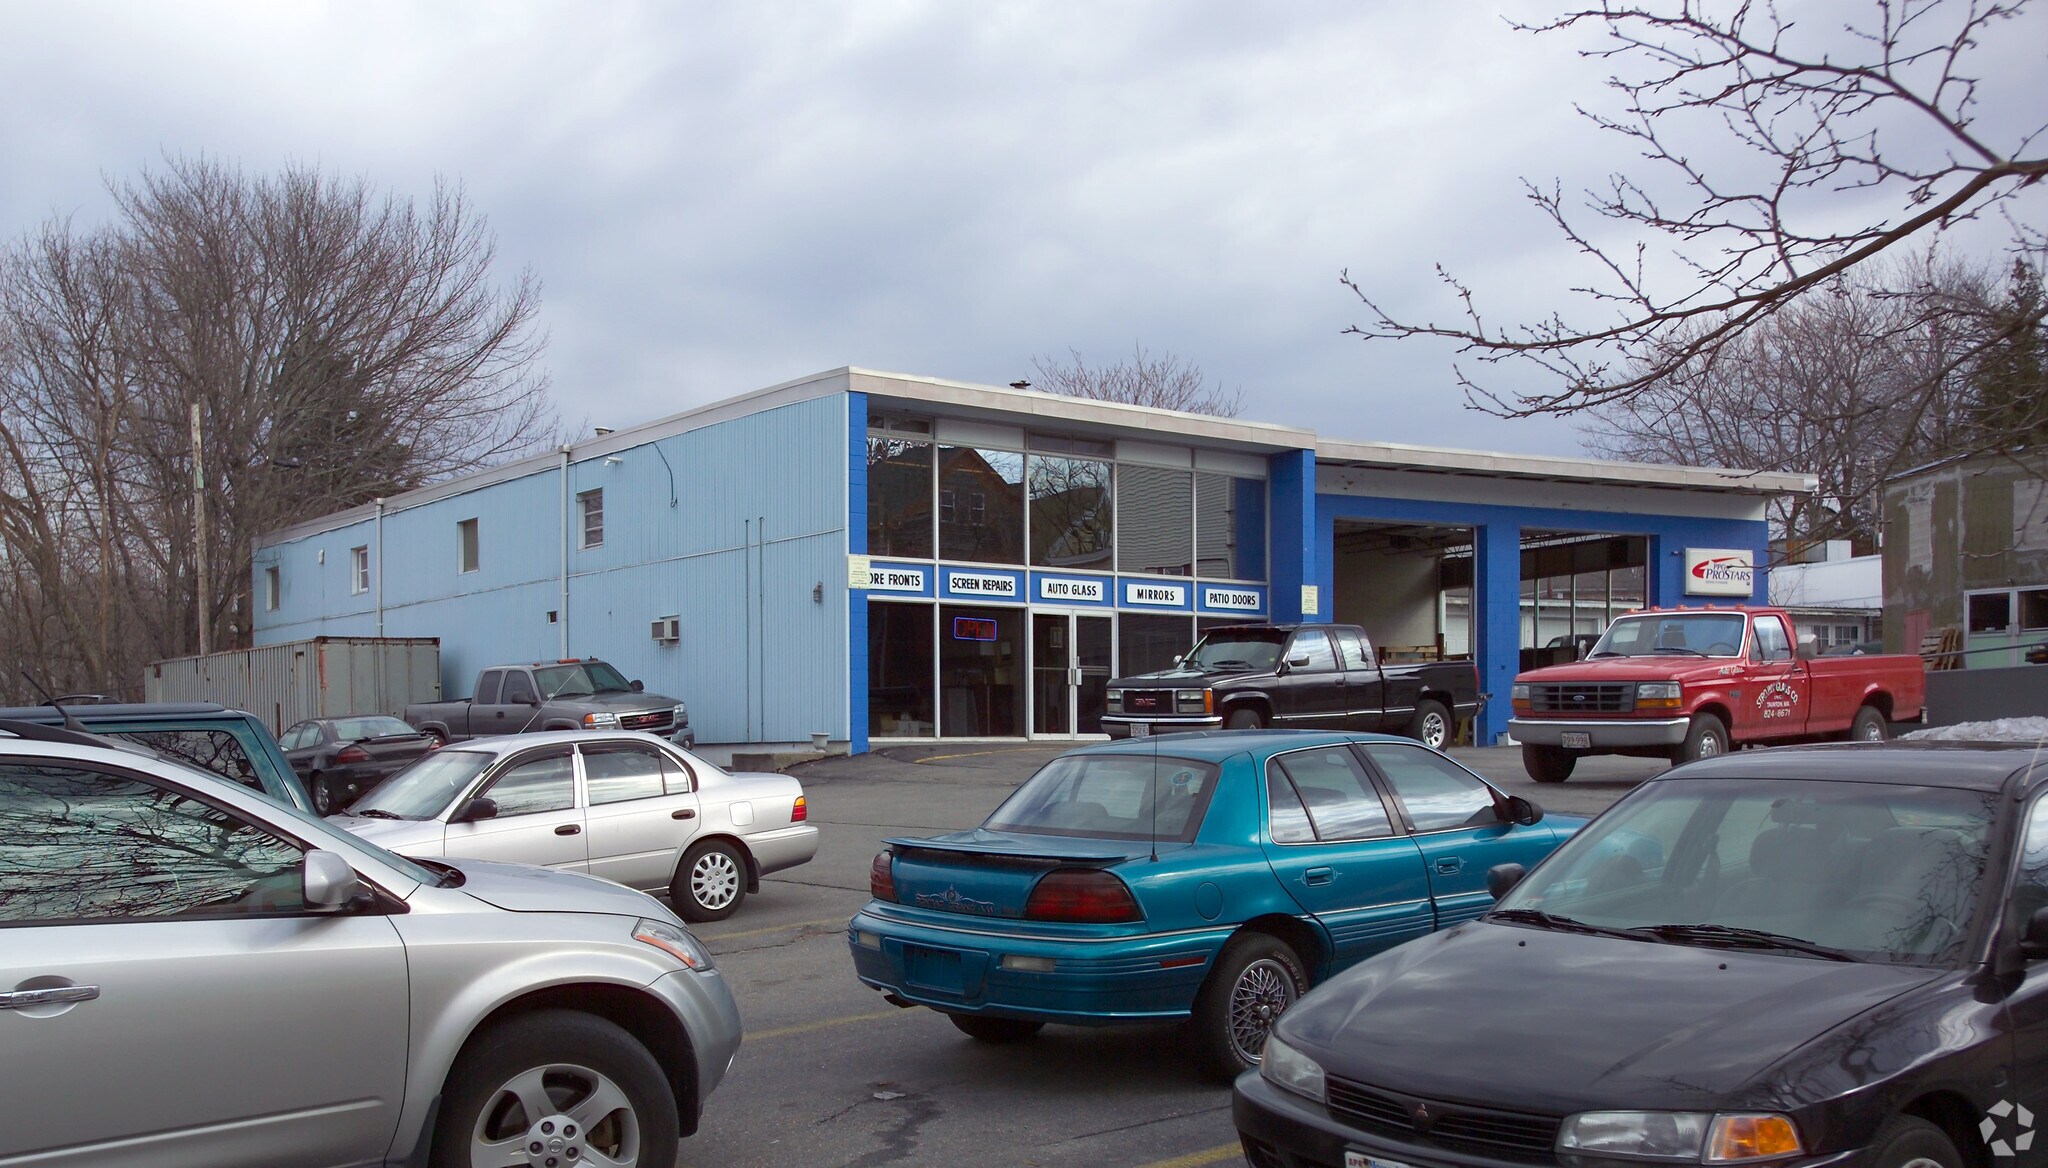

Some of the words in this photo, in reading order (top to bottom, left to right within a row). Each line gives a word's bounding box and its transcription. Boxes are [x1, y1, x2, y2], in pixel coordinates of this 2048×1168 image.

[869, 572, 885, 585] ORE
[888, 573, 921, 586] FRONTS
[952, 577, 979, 590] SCREEN
[982, 579, 1013, 592] REPAIRS
[1047, 583, 1068, 595] AUTO
[1071, 584, 1097, 596] GLASS
[1137, 588, 1175, 601] MIRRORS
[1209, 592, 1230, 604] PATIO
[1232, 594, 1256, 606] DOORS
